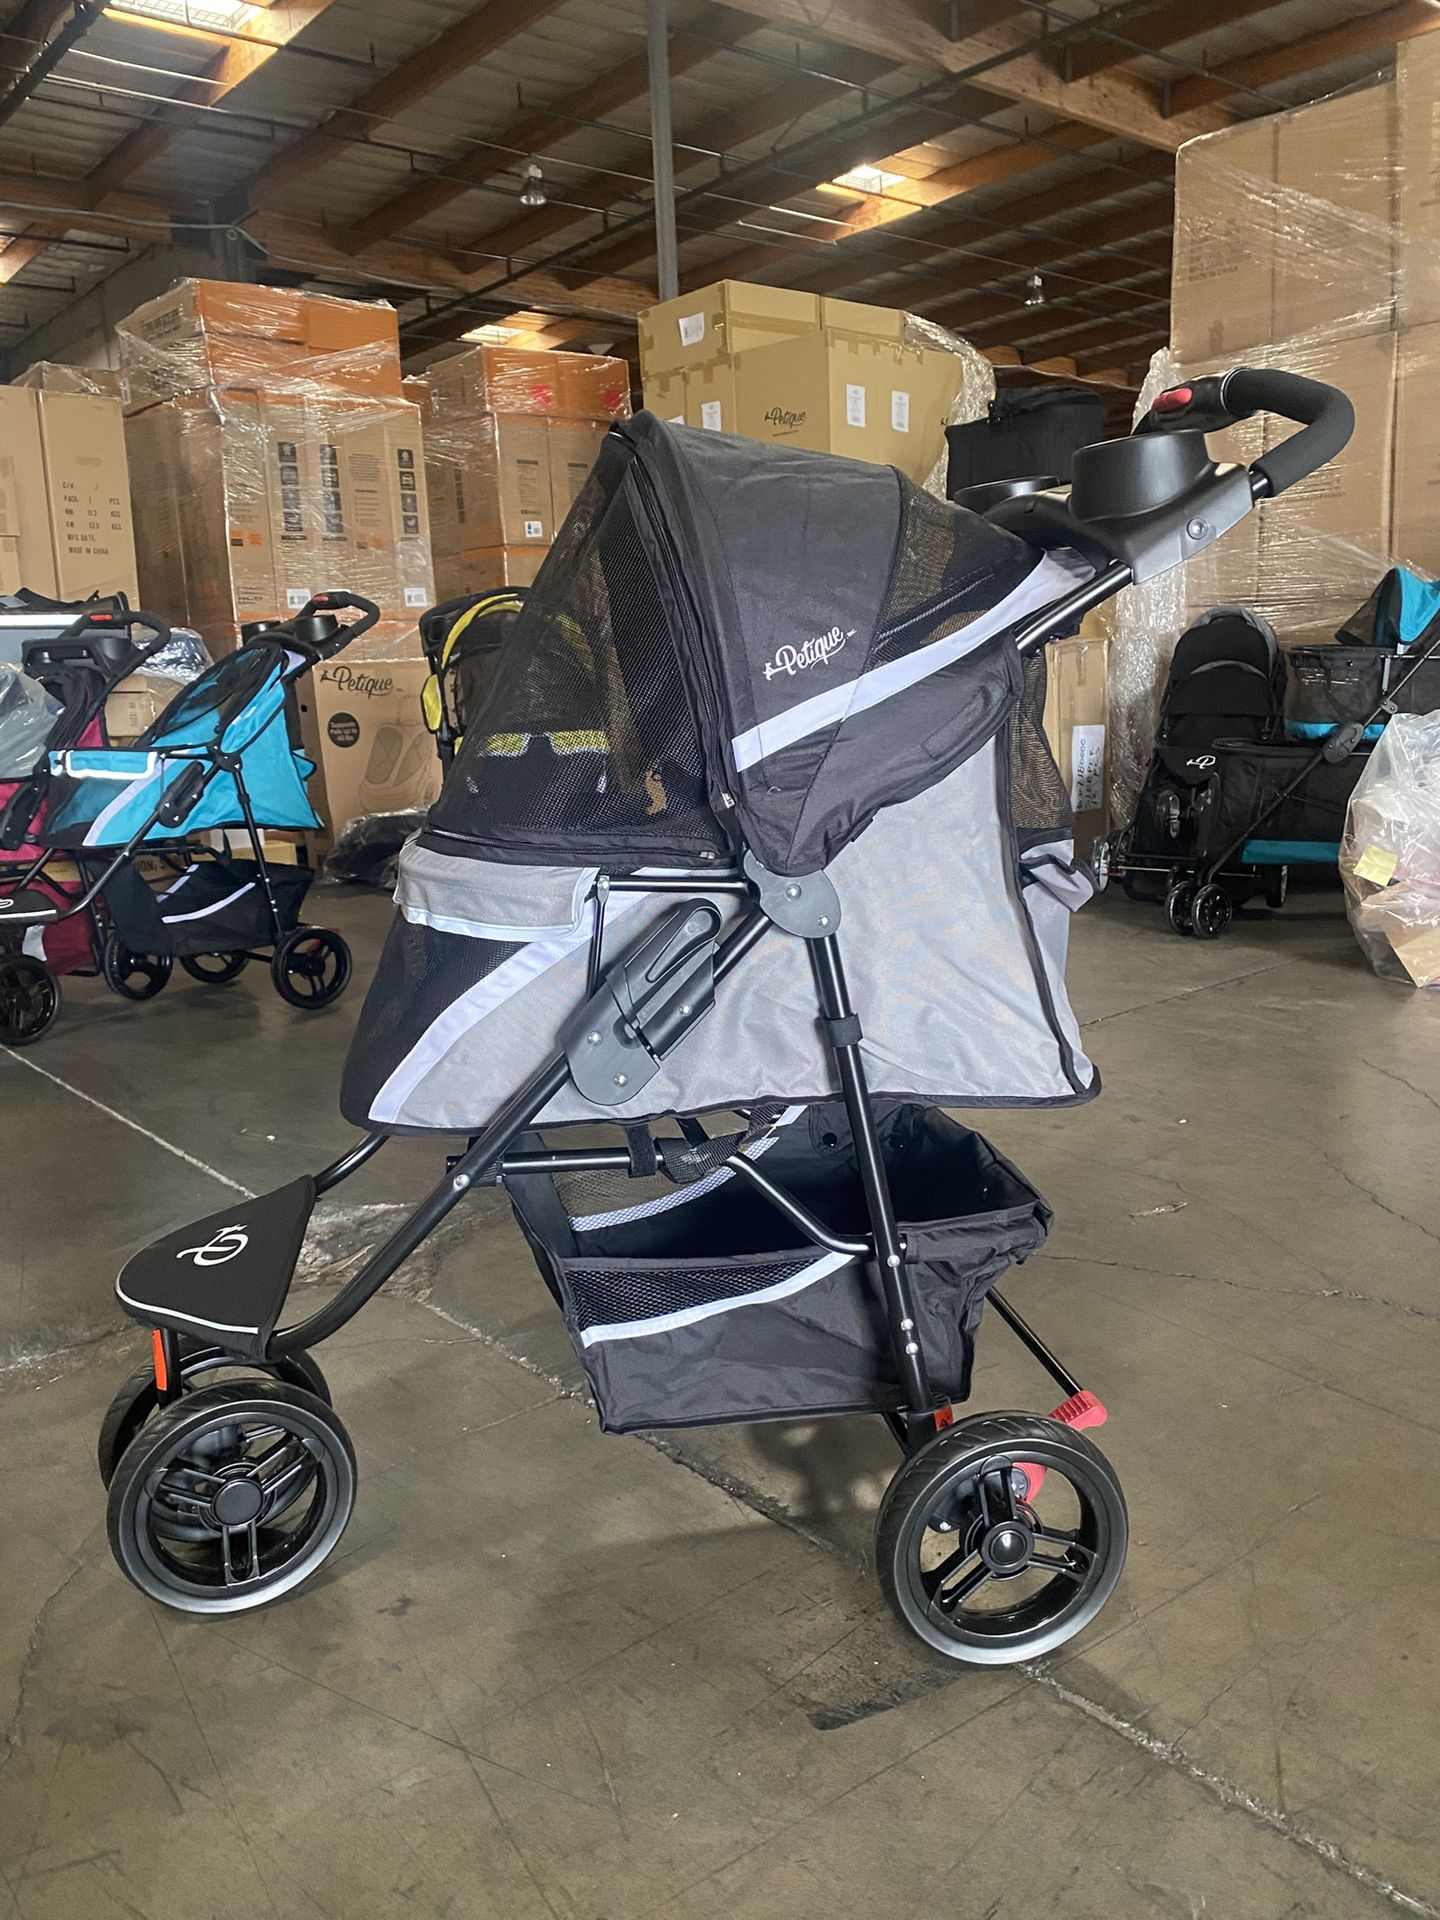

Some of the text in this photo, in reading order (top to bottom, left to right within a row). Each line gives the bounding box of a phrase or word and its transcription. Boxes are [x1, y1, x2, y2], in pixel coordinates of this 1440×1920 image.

[764, 406, 806, 429] Petique
[92, 547, 109, 555] CHINA
[763, 627, 846, 680] Petique
[320, 666, 393, 699] Petique
